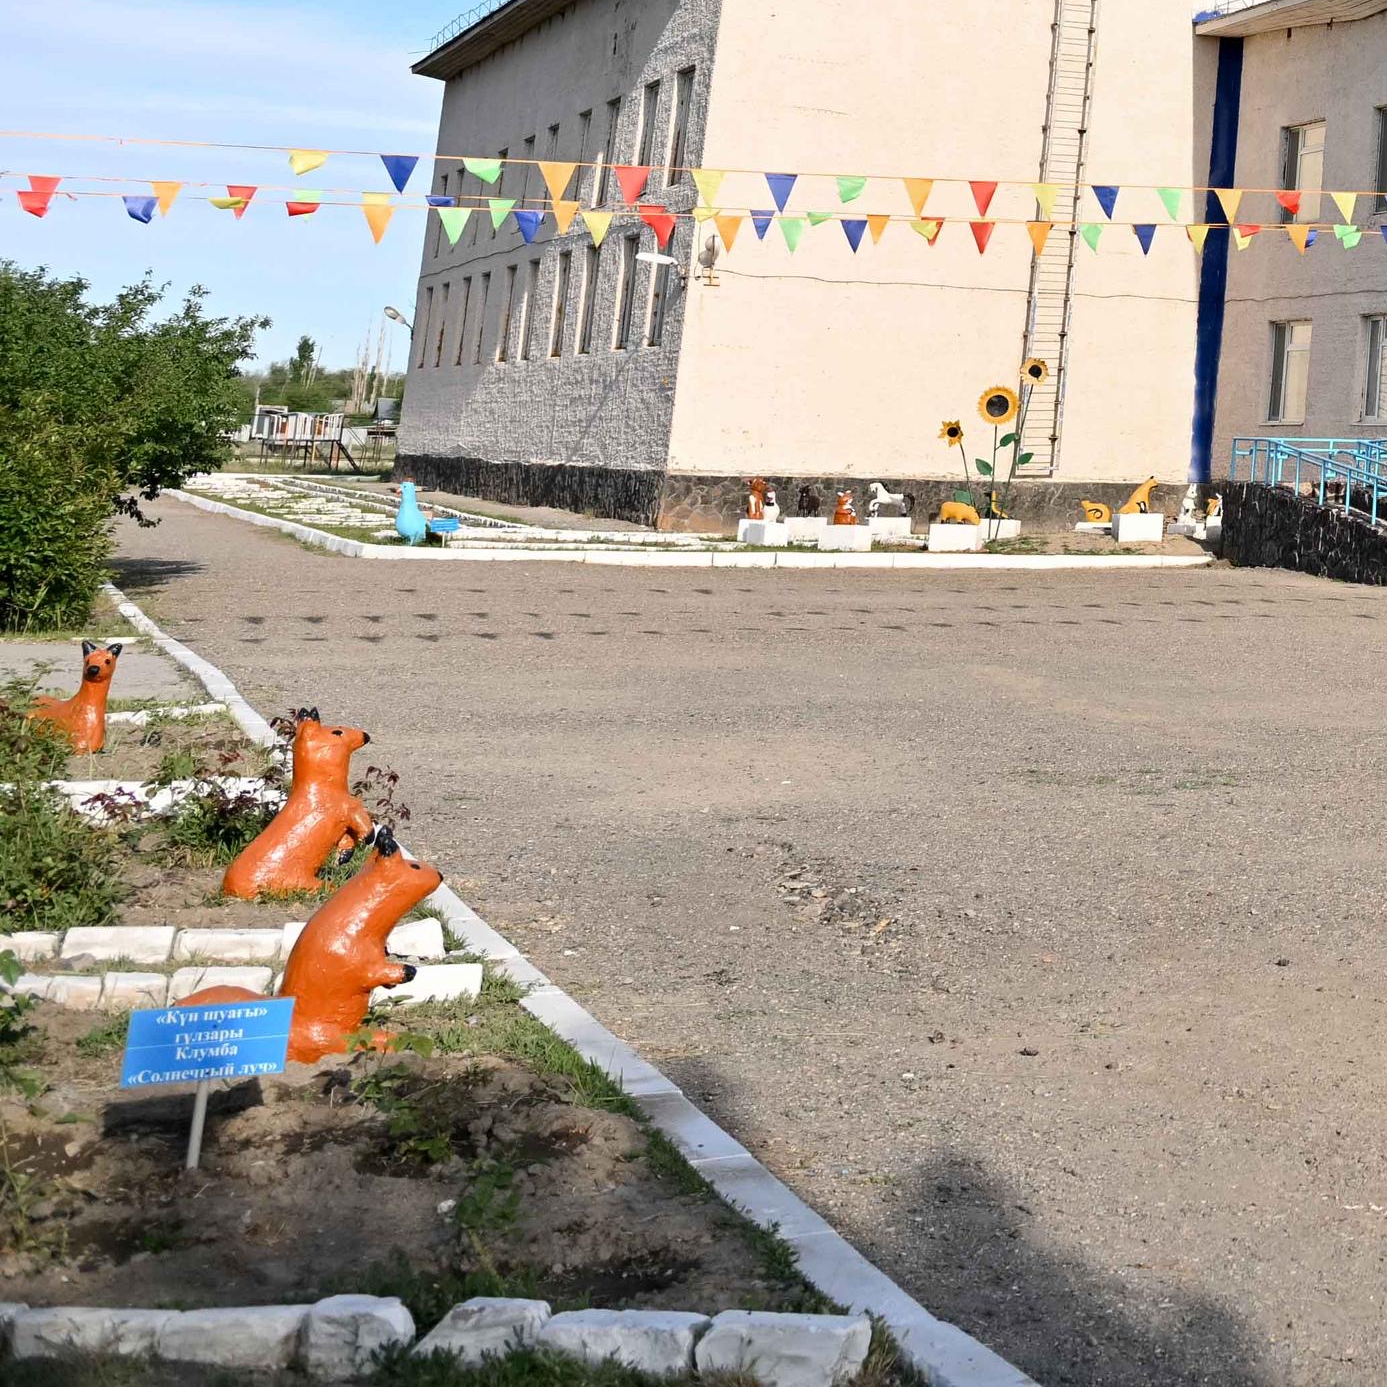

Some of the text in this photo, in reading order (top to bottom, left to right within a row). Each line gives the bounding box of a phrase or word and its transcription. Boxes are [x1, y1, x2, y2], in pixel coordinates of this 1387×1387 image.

[156, 1007, 267, 1025] «Күн шуағы»
[175, 1044, 238, 1060] Клумба
[239, 1062, 277, 1075] луч»
